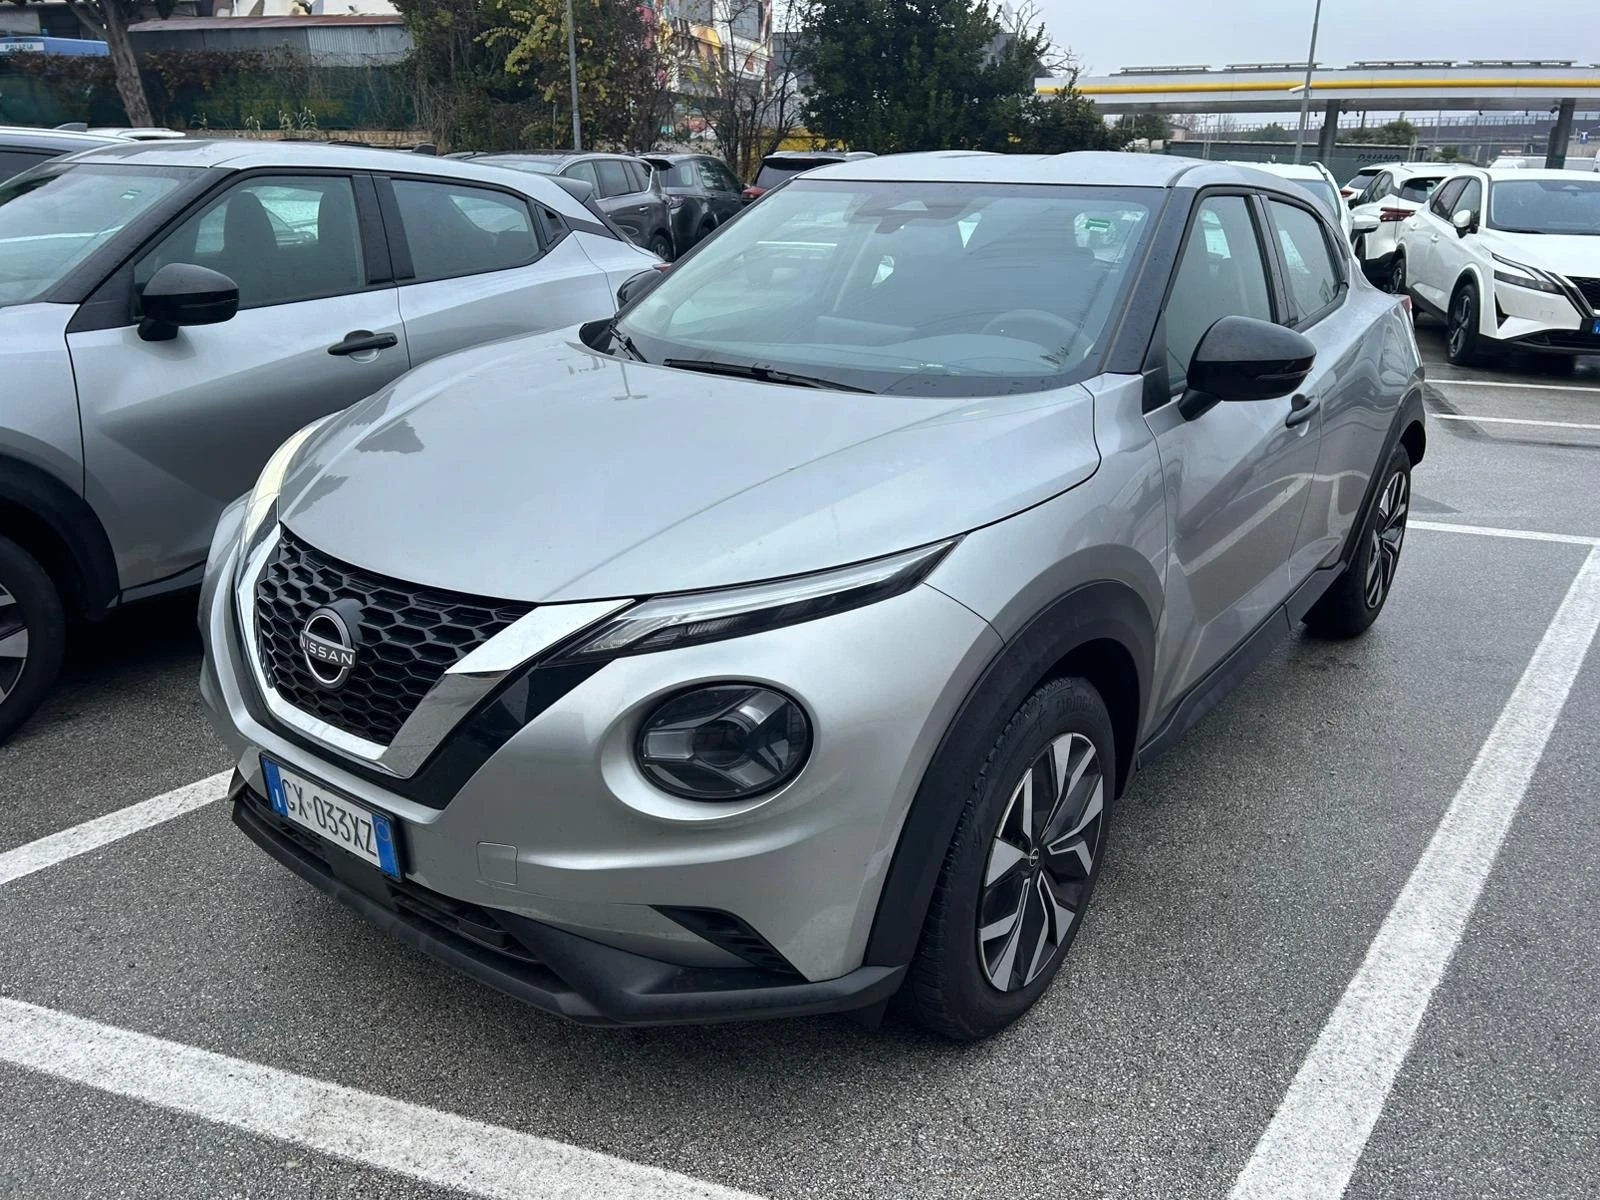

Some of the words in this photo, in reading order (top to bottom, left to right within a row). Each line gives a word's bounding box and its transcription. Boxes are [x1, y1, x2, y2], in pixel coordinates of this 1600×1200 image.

[300, 633, 353, 665] NISSAN
[282, 779, 308, 820] GX
[313, 795, 377, 857] 033XZ
